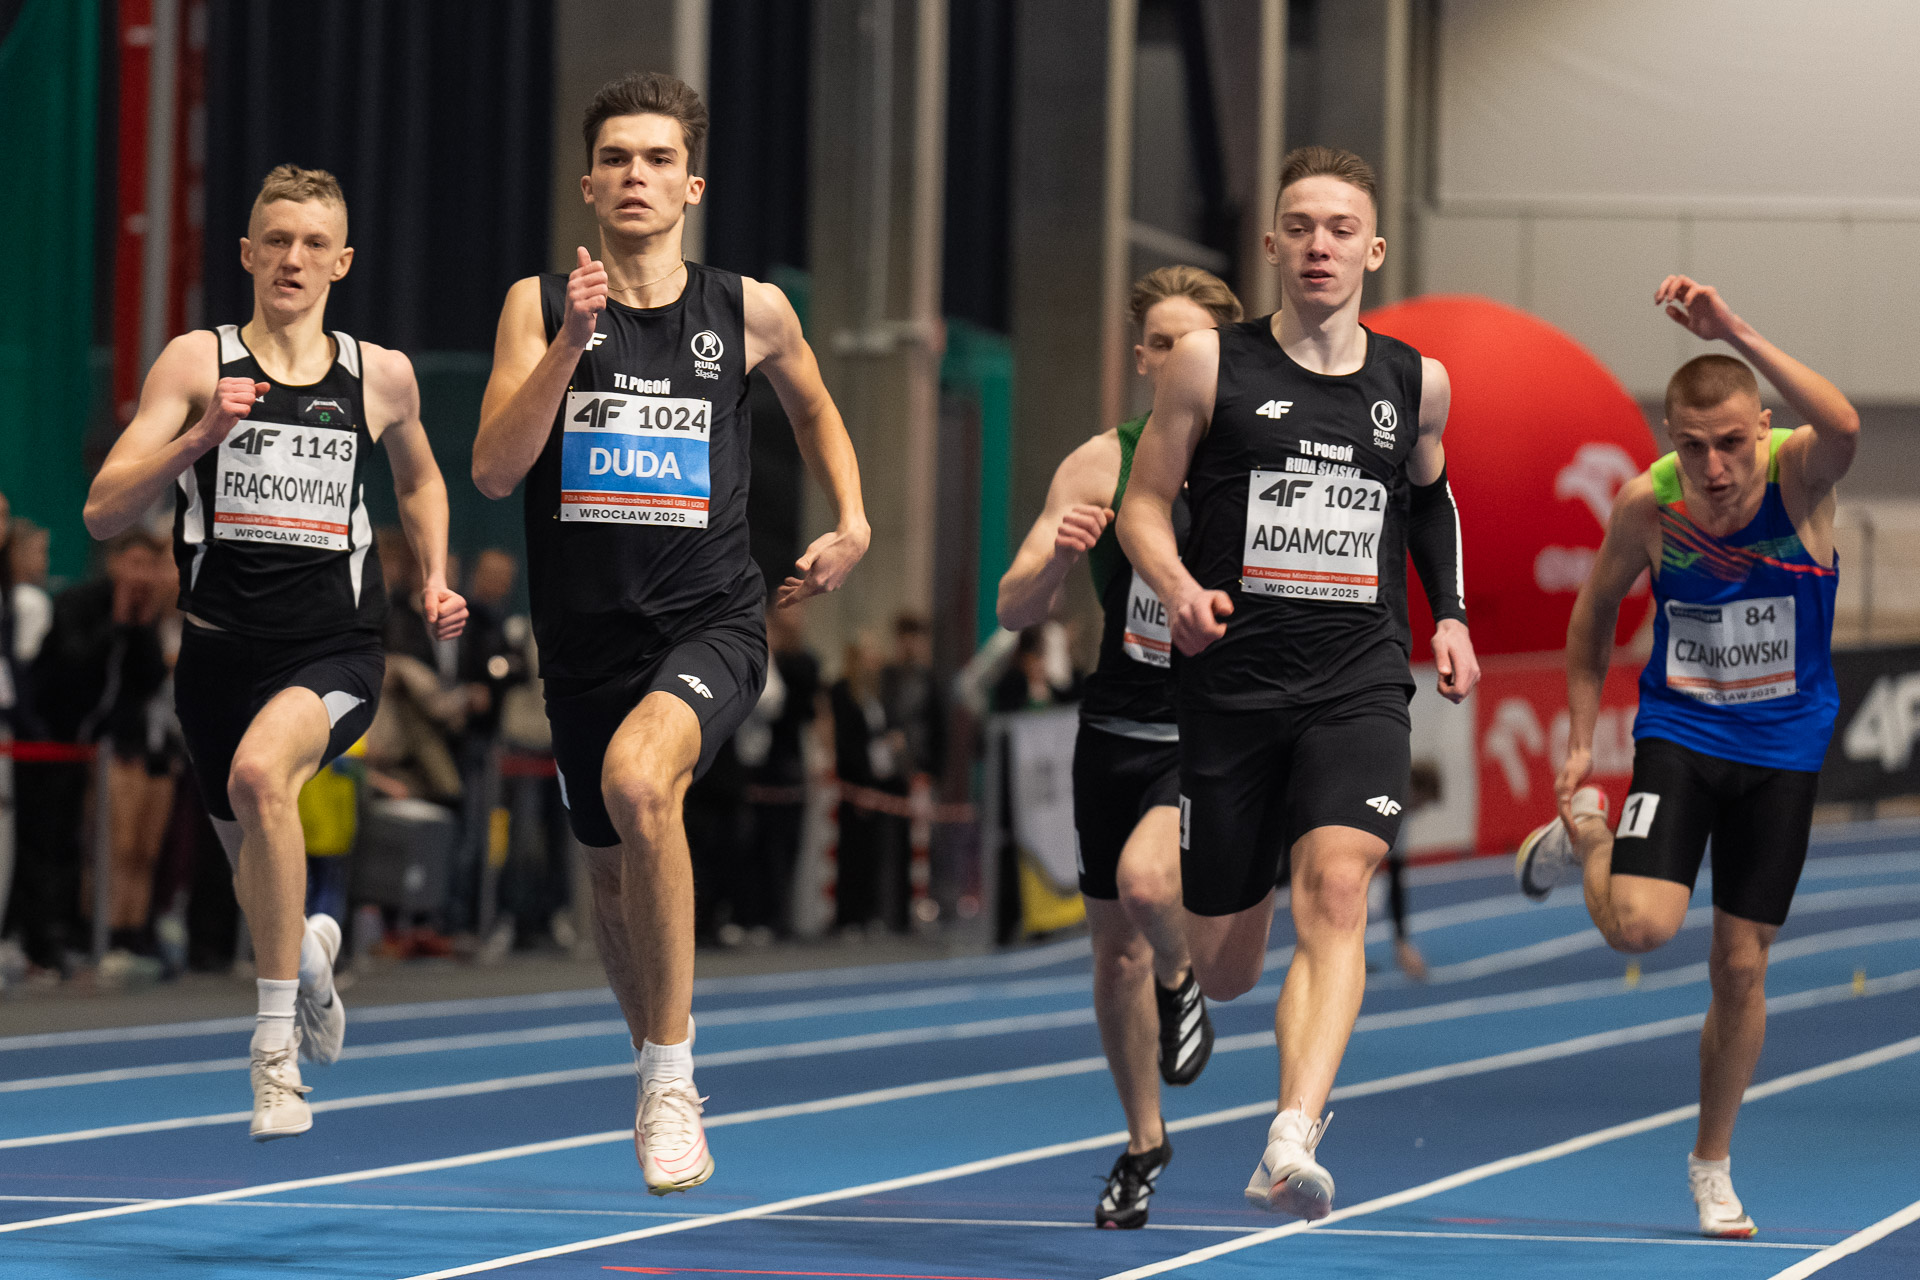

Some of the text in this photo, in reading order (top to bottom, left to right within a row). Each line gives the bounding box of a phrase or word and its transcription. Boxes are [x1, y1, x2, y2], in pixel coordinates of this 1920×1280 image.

[585, 332, 607, 351] F
[694, 360, 721, 372] RUDA
[695, 368, 719, 380] Śląska
[613, 373, 671, 395] TL POGOŃ
[573, 398, 627, 428] 4F
[638, 405, 706, 434] 1024
[1256, 400, 1294, 419] 4F
[228, 427, 281, 455] 4F
[1373, 428, 1396, 442] RUDA
[1373, 437, 1394, 450] Śląska
[292, 434, 353, 462] 1143
[1299, 439, 1354, 463] TL POGOŃ
[589, 447, 682, 480] DUDA
[1285, 457, 1317, 475] RUDA
[224, 470, 348, 508] FRĄCKOWIAK
[1258, 478, 1314, 508] 4F
[1324, 484, 1381, 512] 1021
[580, 495, 606, 503] Halowe
[607, 496, 651, 505] Mistrzostwa
[652, 498, 674, 506] Polski
[579, 508, 686, 523] WROCŁAW 2025
[234, 528, 330, 545] WROCŁAW 2025
[1252, 524, 1376, 558] ADAMCZYK
[1264, 583, 1359, 598] WROCŁAW 2025
[1746, 604, 1776, 626] 84
[1143, 652, 1170, 665] WRO
[1675, 639, 1788, 669] CZAJKOWSKI
[677, 674, 714, 698] 4F
[1366, 795, 1402, 816] 4F
[1628, 797, 1644, 832] 1
